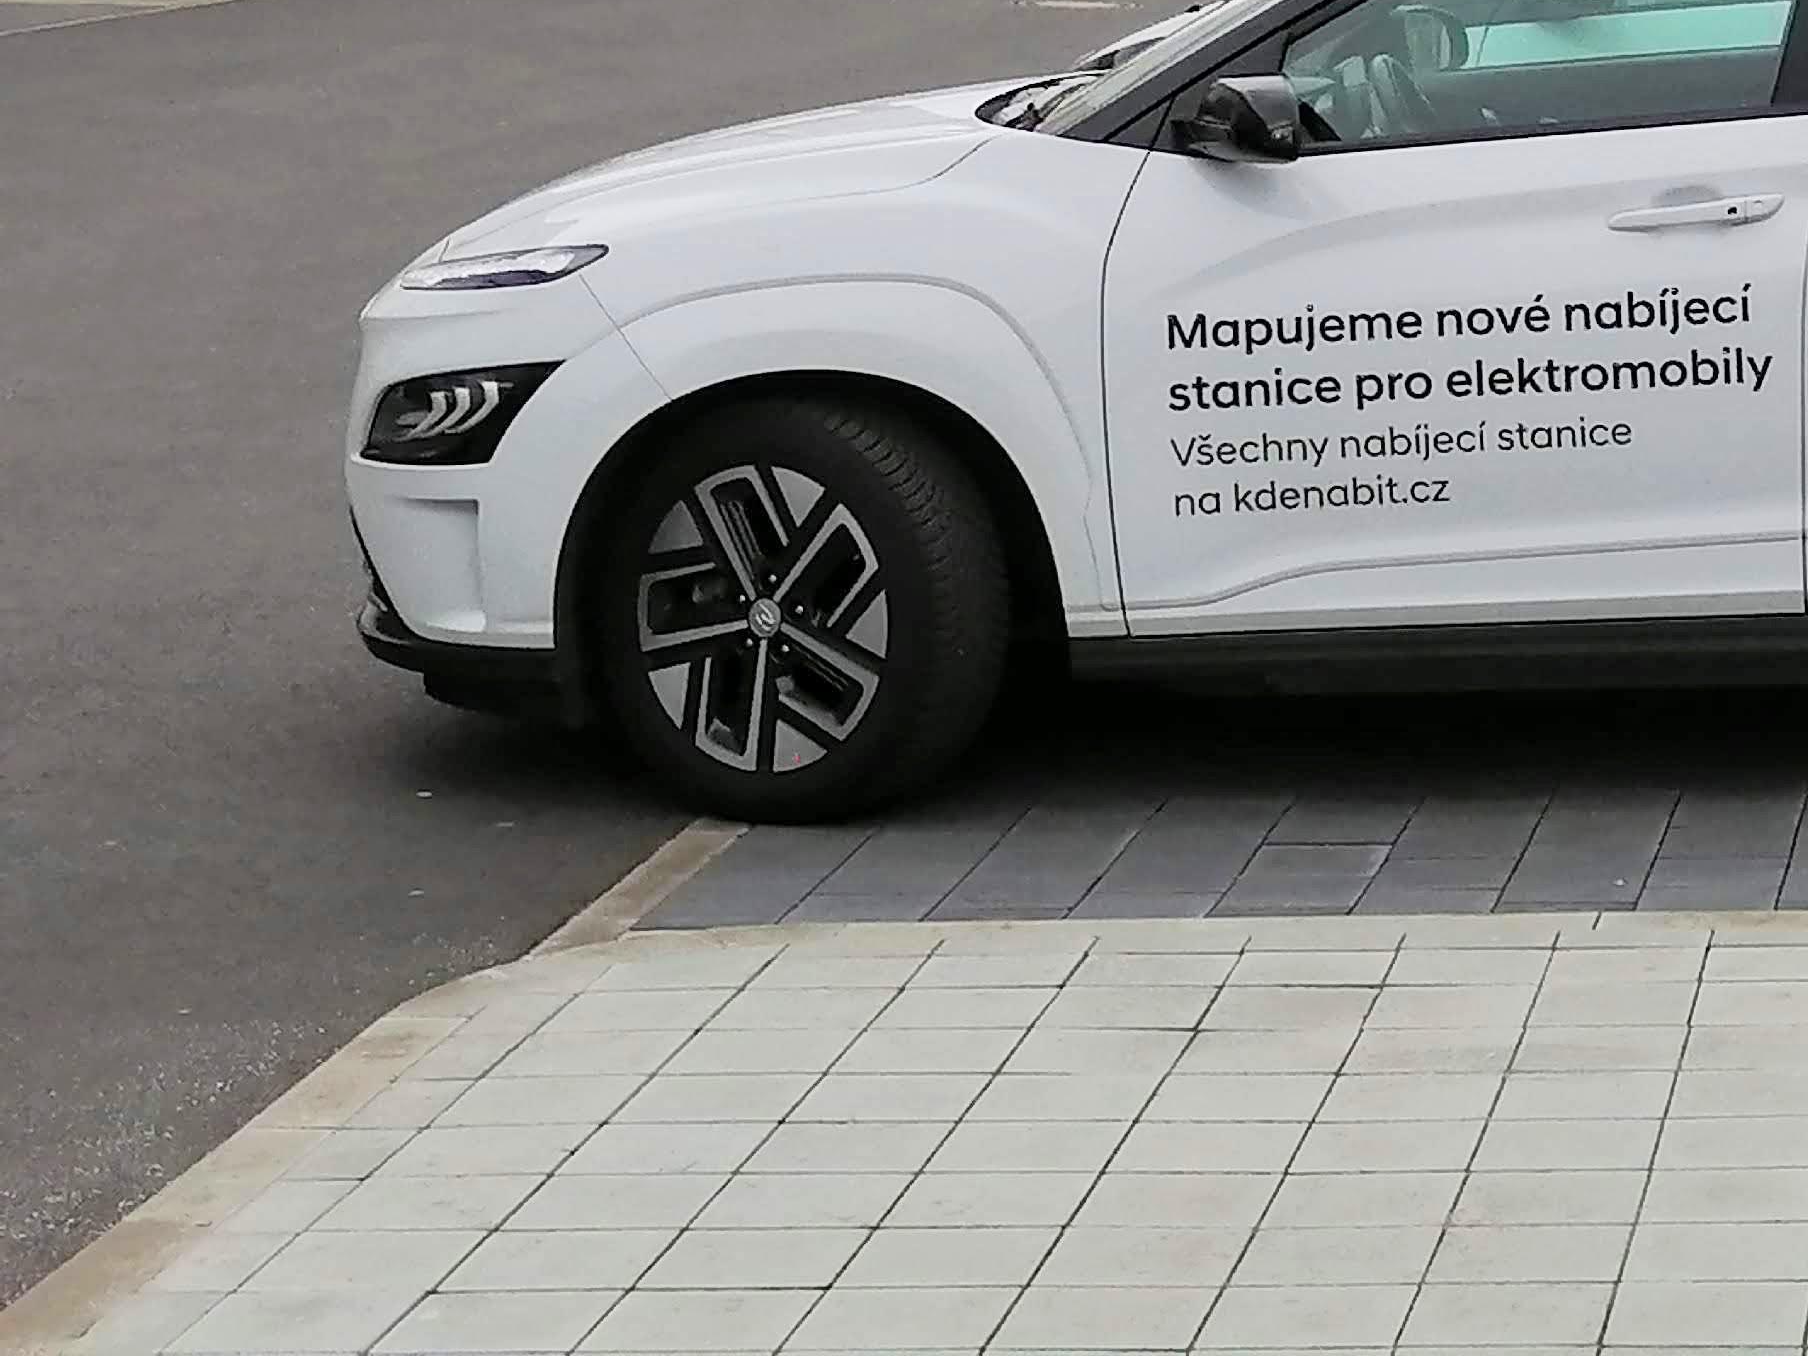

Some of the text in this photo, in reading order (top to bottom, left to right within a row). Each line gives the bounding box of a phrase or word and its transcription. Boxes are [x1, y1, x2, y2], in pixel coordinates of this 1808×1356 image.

[1167, 284, 1753, 356] Mapujeme nové nabíjecí
[1168, 347, 1773, 412] stanice pro elektromobily
[1170, 418, 1633, 469] Všechny nabíjecí stanice
[1174, 475, 1450, 518] na kdenabit.cz
